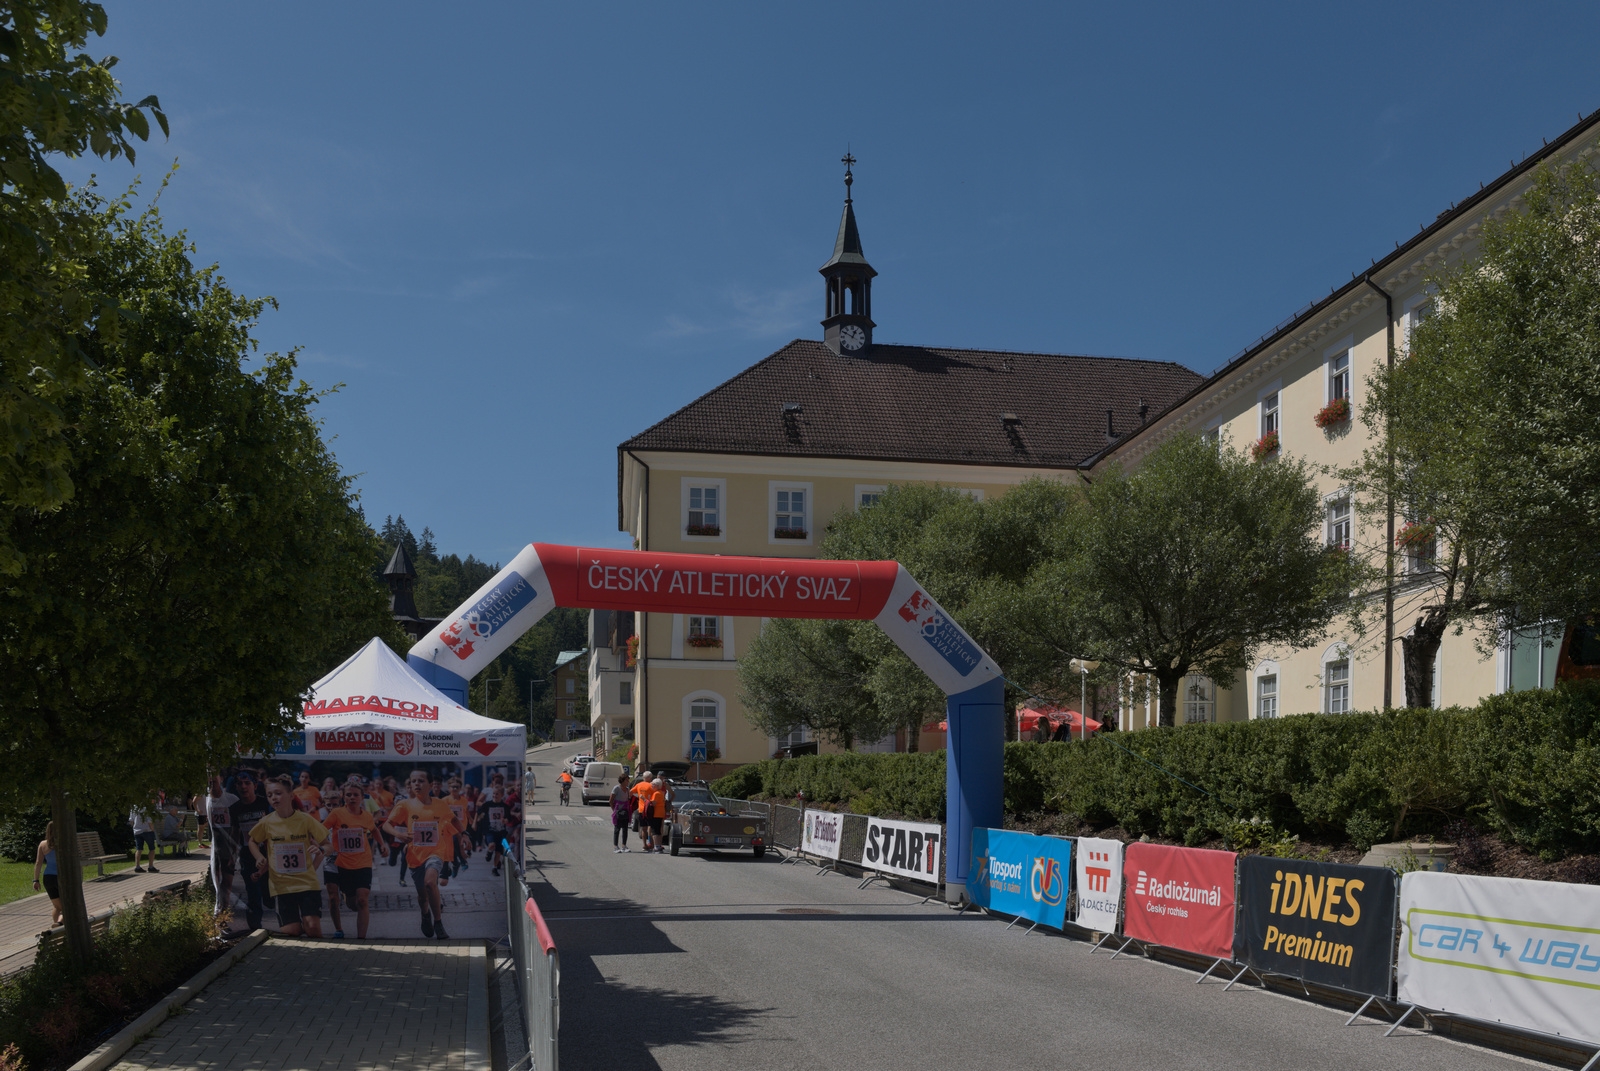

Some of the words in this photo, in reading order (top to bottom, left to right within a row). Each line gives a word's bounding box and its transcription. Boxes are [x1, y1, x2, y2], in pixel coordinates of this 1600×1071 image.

[588, 559, 664, 592] ČESKÝ
[668, 570, 790, 599] ATLETICKÝ
[796, 576, 851, 601] SVAZ
[477, 587, 503, 612] ČESKÝ
[484, 579, 526, 620] ATLETICKÝ
[491, 605, 514, 627] SVAZ
[931, 636, 953, 657] SVAZ
[939, 630, 977, 667] ATLETICKÝ
[304, 695, 439, 714] MARATON
[400, 710, 434, 720] stav
[315, 731, 385, 743] MARATON
[422, 733, 454, 741] NÁRODNÍ
[422, 741, 461, 749] SPORTOVNÍ
[213, 814, 226, 824] 28
[342, 837, 361, 849] 108
[420, 831, 433, 842] 12
[866, 824, 940, 874] START
[282, 854, 299, 869] 33
[989, 856, 1022, 880] Tipsport
[1007, 882, 1022, 894] námi
[1148, 877, 1221, 907] Radiožurnál
[1269, 868, 1366, 927] iDNES
[1104, 899, 1117, 914] ČEZ
[1146, 900, 1167, 916] Český
[1167, 906, 1189, 919] rozhlas
[1263, 925, 1354, 968] Premium
[1492, 934, 1512, 959] 4
